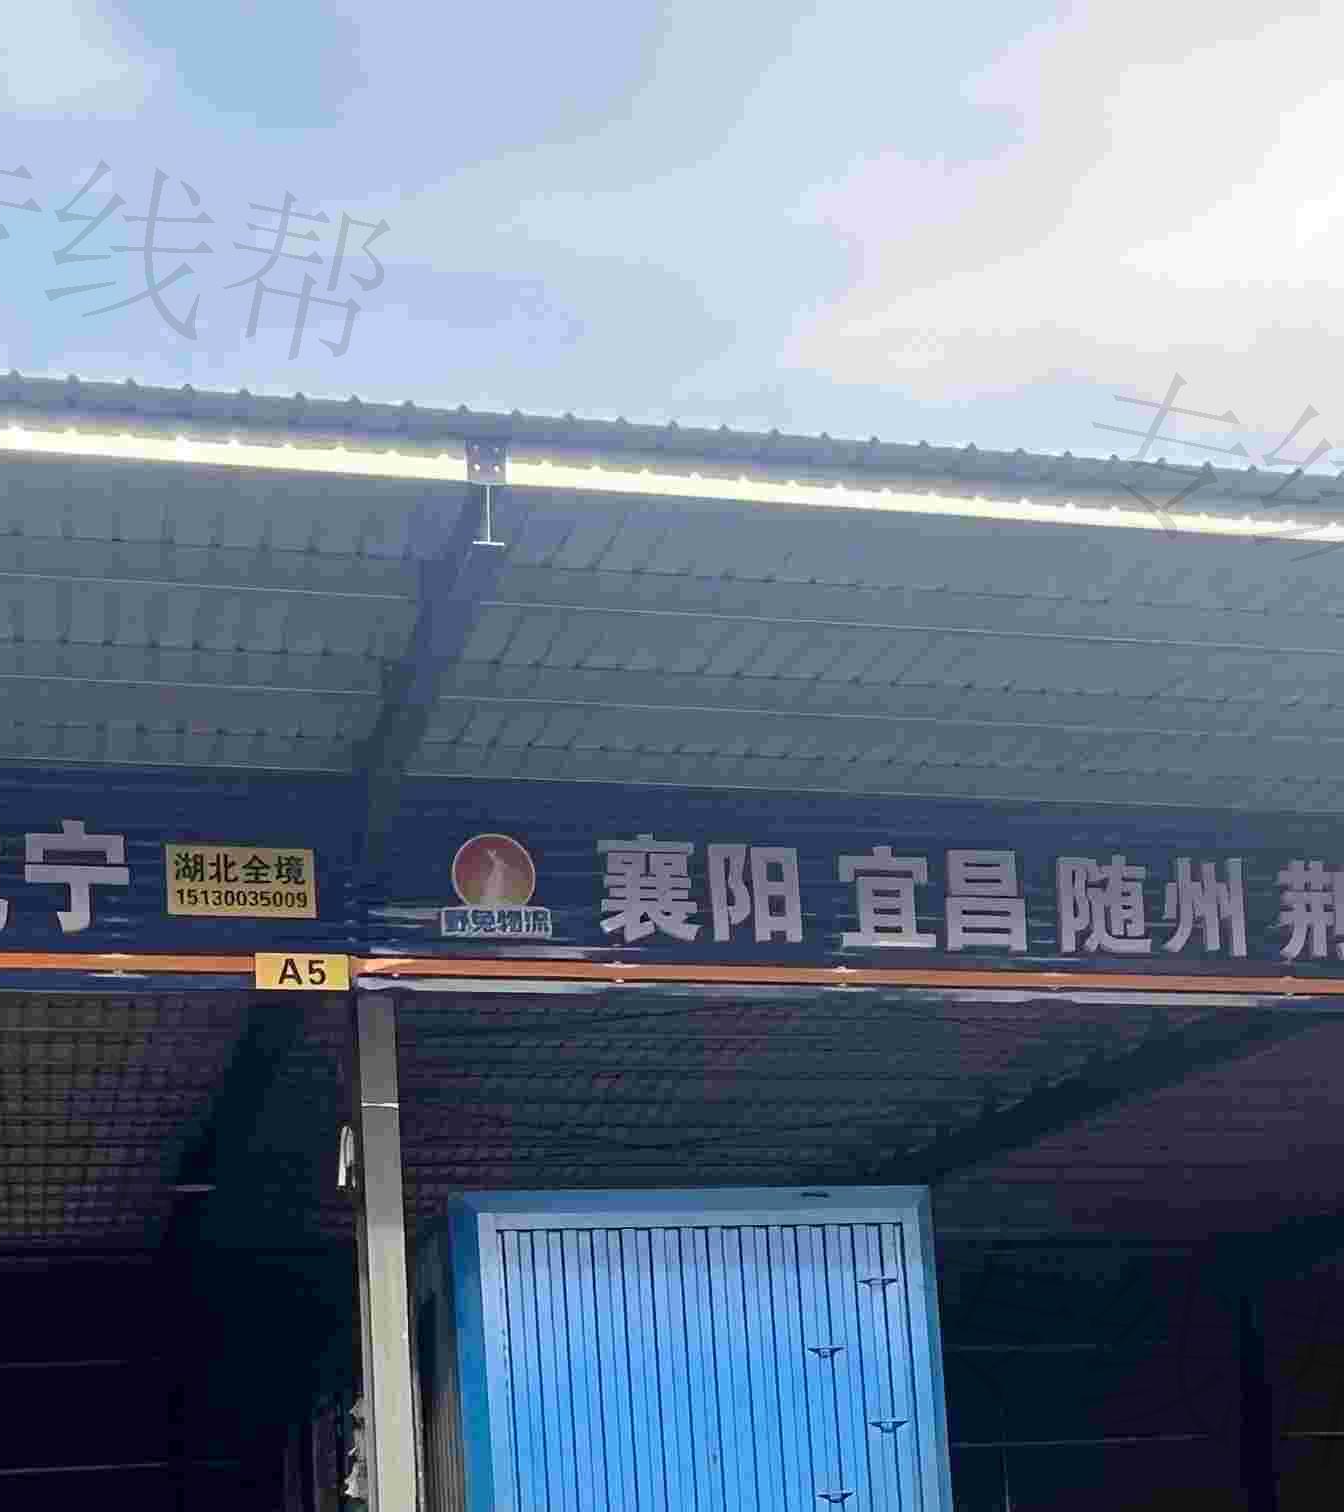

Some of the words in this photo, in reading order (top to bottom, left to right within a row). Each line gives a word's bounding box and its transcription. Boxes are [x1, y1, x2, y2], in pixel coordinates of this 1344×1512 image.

[173, 852, 306, 885] 湖北全境
[597, 833, 803, 943] 襄阳
[839, 846, 1028, 952] 宜昌
[1057, 855, 1251, 957] 随州
[277, 958, 327, 986] A5
